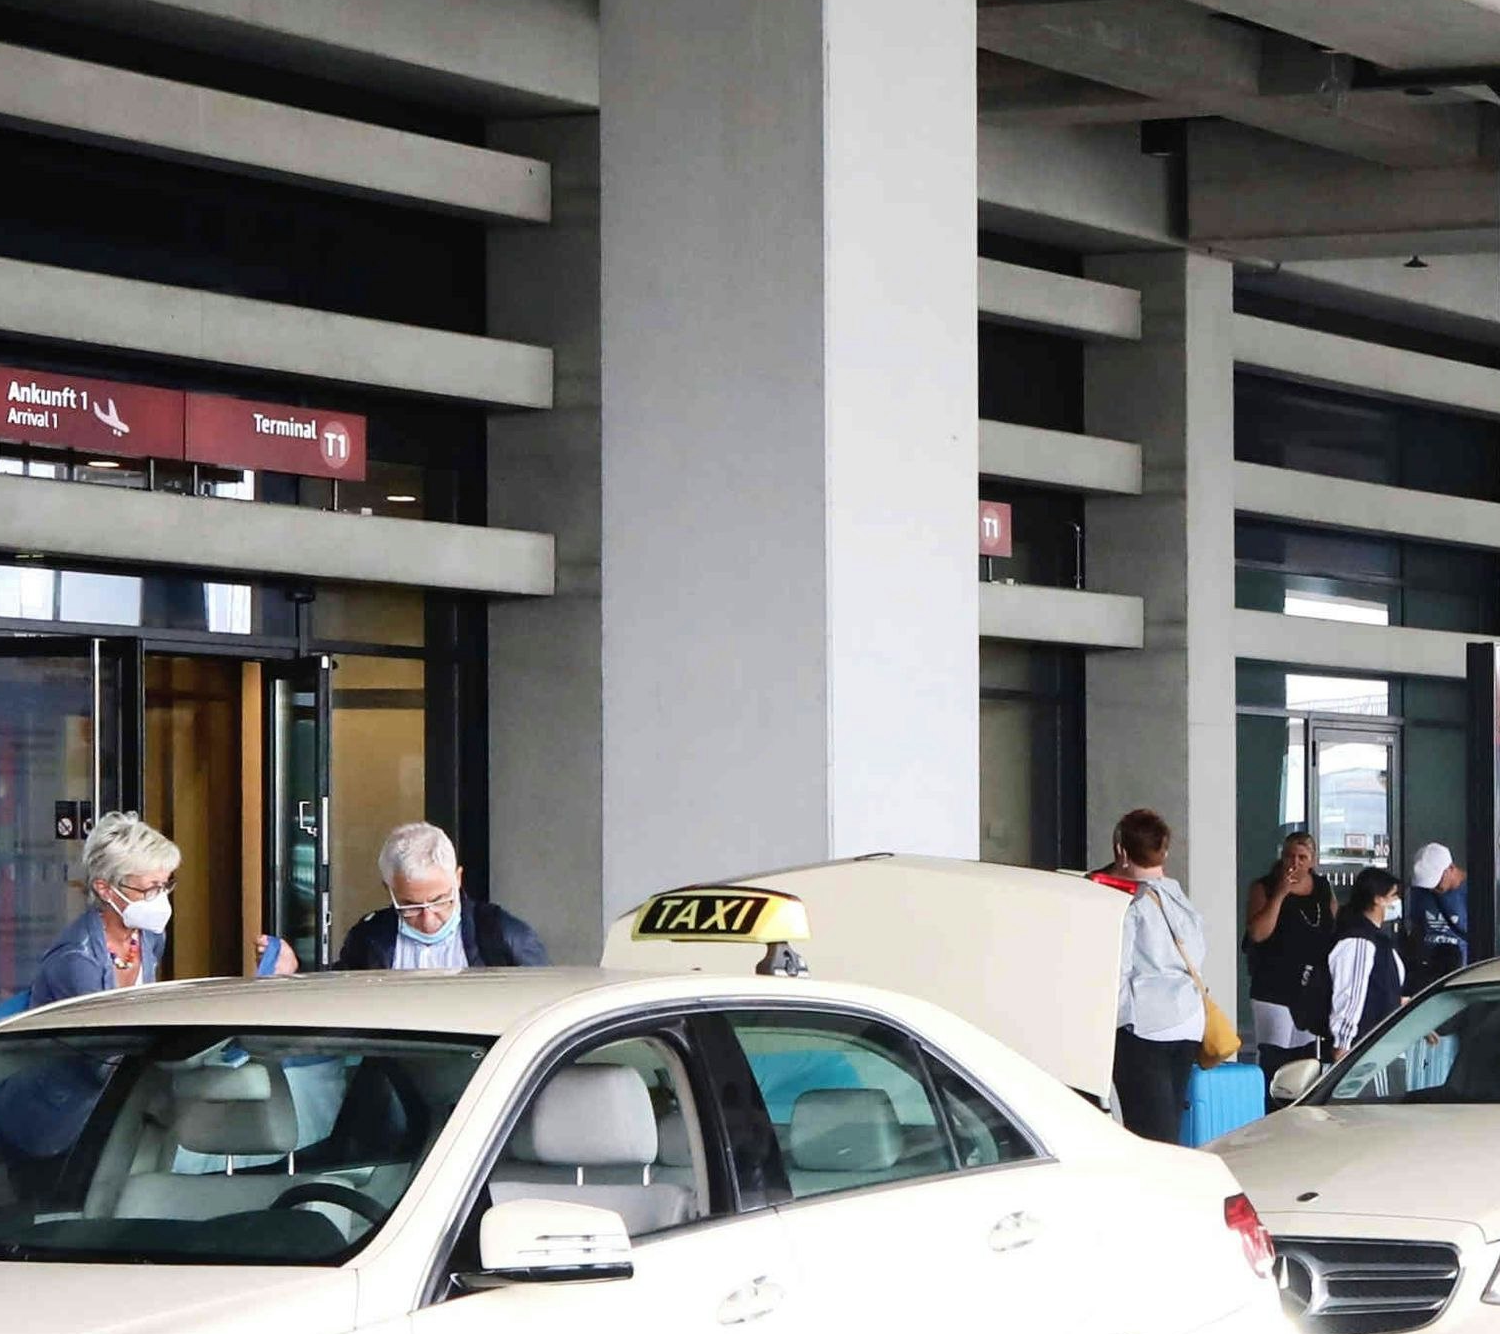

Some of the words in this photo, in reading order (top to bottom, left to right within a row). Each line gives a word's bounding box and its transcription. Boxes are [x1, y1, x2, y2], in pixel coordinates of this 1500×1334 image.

[8, 381, 77, 409] Ankunft
[80, 391, 88, 410] 1
[8, 407, 50, 428] Arrival
[52, 413, 58, 428] 1
[253, 413, 317, 439] Terminal
[323, 433, 345, 459] T1
[983, 518, 998, 537] T1
[655, 899, 755, 931] TAXI
